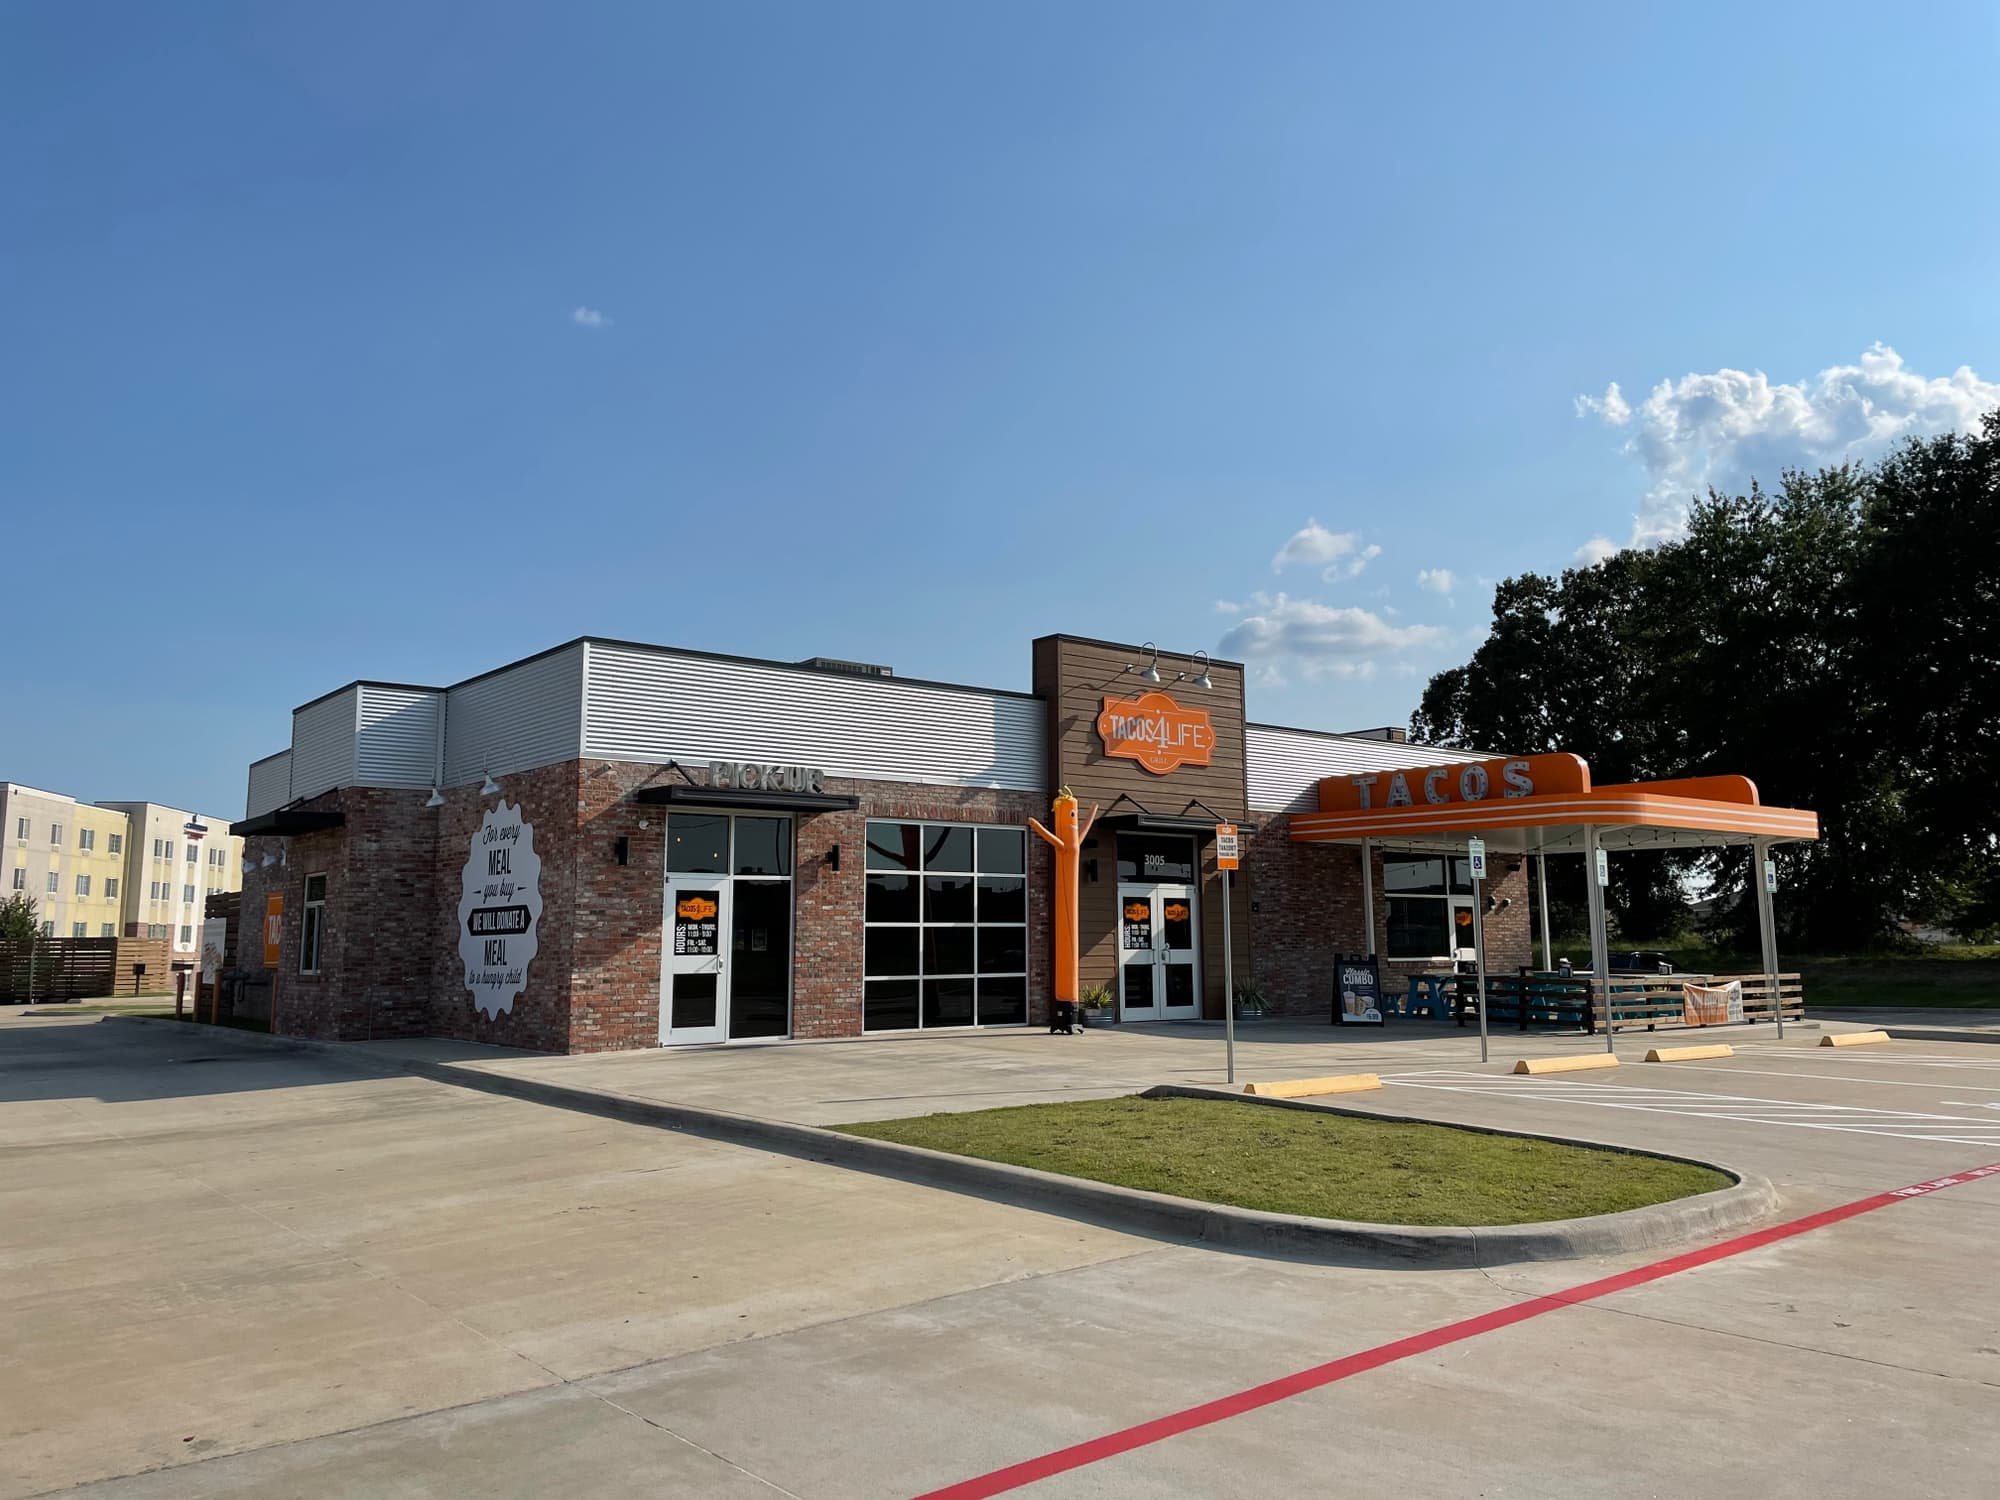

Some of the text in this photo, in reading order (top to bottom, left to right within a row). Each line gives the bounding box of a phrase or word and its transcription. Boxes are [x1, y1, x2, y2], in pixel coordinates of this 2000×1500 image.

[1352, 761, 1534, 810] TACOS
[482, 824, 521, 845] For every
[488, 848, 512, 876] MEAL
[1144, 854, 1165, 866] 3005
[483, 879, 515, 904] you buy
[473, 909, 525, 931] WE WILL DONATE A
[675, 923, 687, 953] HOURS:
[484, 939, 507, 966] MEAL
[469, 969, 475, 984] to
[481, 970, 504, 990] hungry
[505, 967, 522, 984] child
[1343, 974, 1374, 985] COMBO
